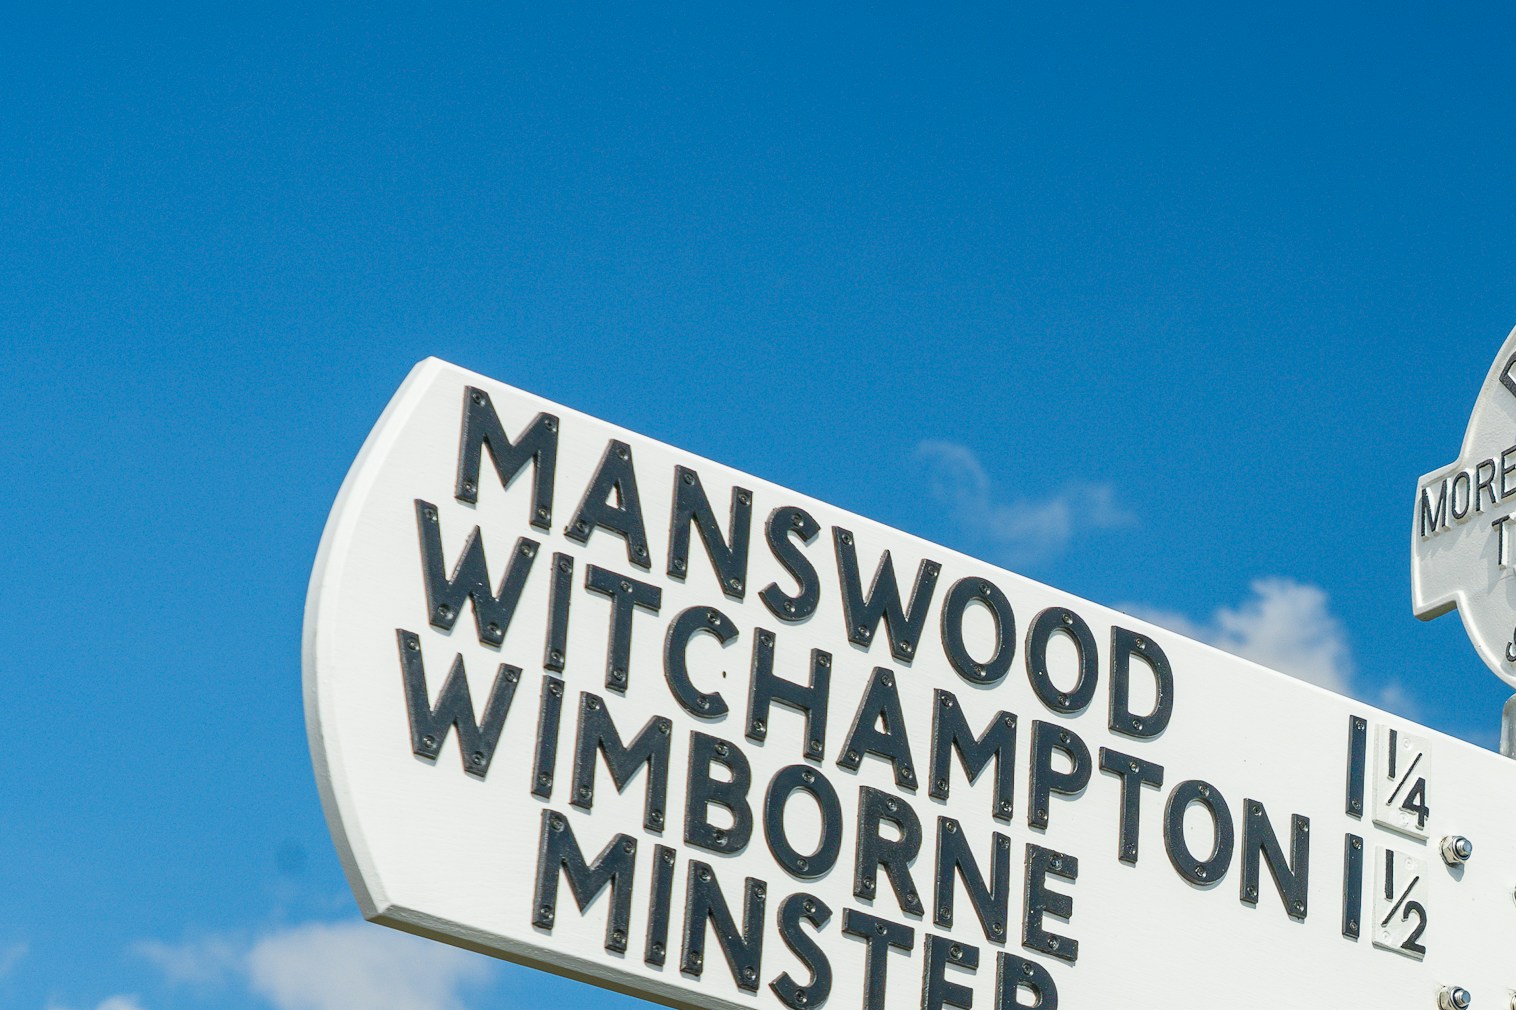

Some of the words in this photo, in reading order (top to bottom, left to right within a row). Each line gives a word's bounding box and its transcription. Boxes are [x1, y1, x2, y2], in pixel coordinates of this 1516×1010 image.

[415, 499, 1310, 923] WITCHAMPTON
[455, 386, 1174, 740] MANSWOOD
[396, 629, 1079, 966] WIMBORNE
